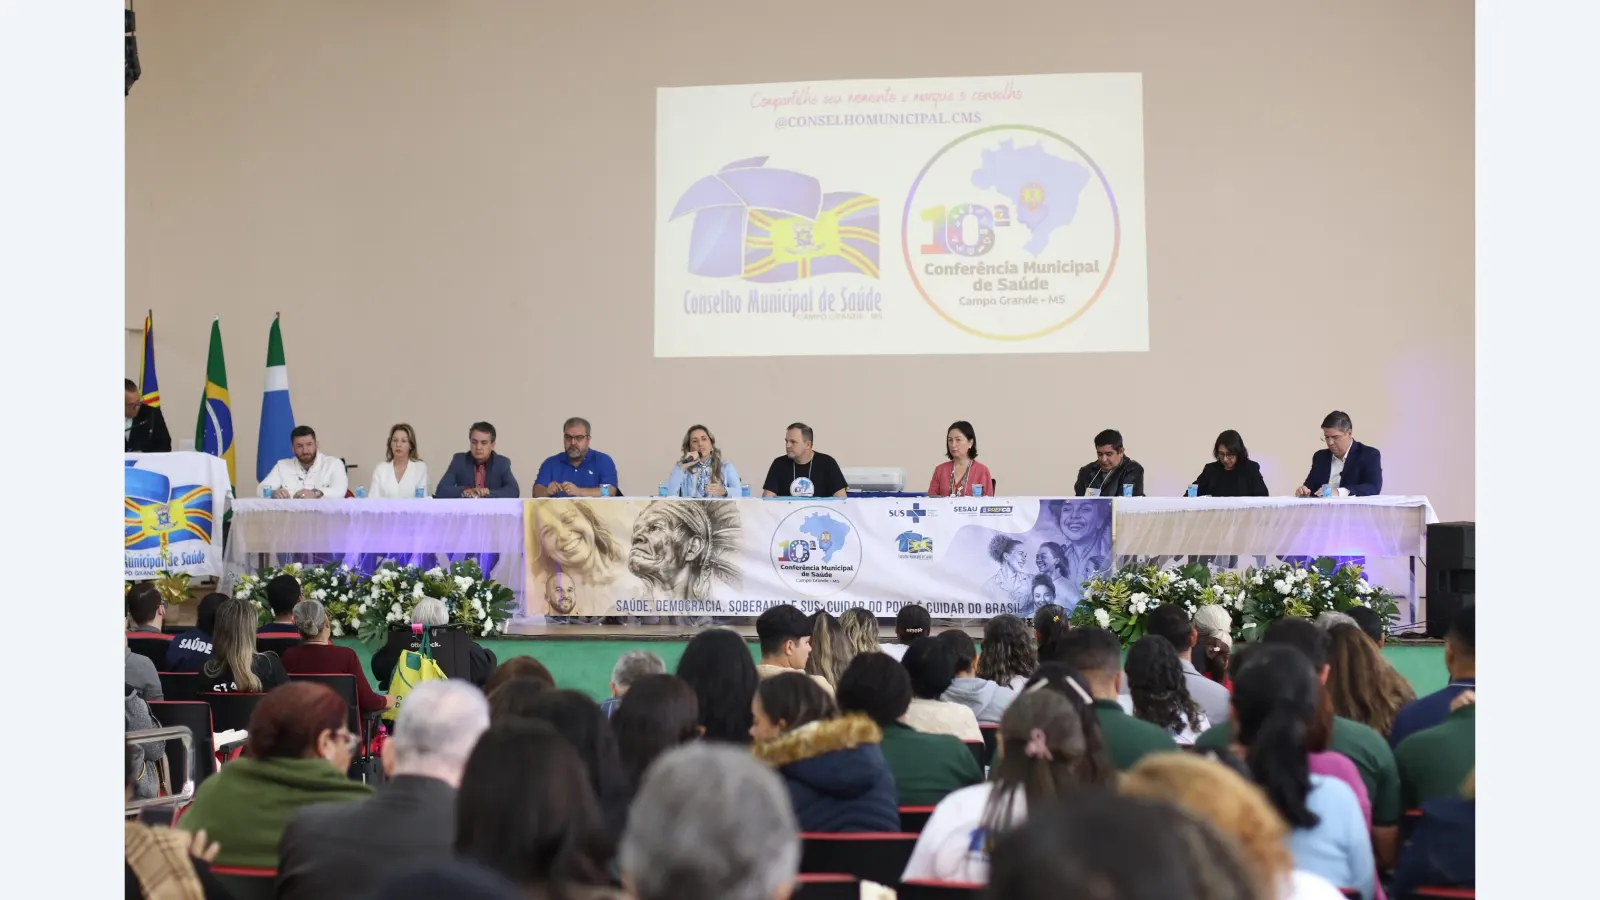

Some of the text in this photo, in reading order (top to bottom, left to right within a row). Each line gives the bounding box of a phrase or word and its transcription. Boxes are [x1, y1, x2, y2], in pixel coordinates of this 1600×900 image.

[823, 92, 843, 105] seu
[972, 79, 1023, 102] conselho
[775, 111, 983, 130] @CONSELHOMUNICIPAL.CMS
[924, 259, 1100, 277] Conferência Municipal
[972, 276, 1049, 292] de Saúde
[683, 285, 882, 318] Conselho Municipal de Saúde
[958, 296, 997, 307] Campo
[999, 294, 1039, 305] Grande
[1048, 294, 1066, 305] MS
[888, 509, 905, 518] SUS
[181, 549, 206, 566] Saúde
[780, 564, 853, 573] Conferência Municipal
[616, 598, 653, 613] SAÚDE,
[655, 600, 725, 613] DEMOCRACIA,
[869, 600, 882, 612] DO
[926, 601, 965, 614] CUIDAR
[968, 602, 981, 614] DO
[985, 602, 1022, 614] BRASIL
[179, 637, 213, 655] SAÚDE
